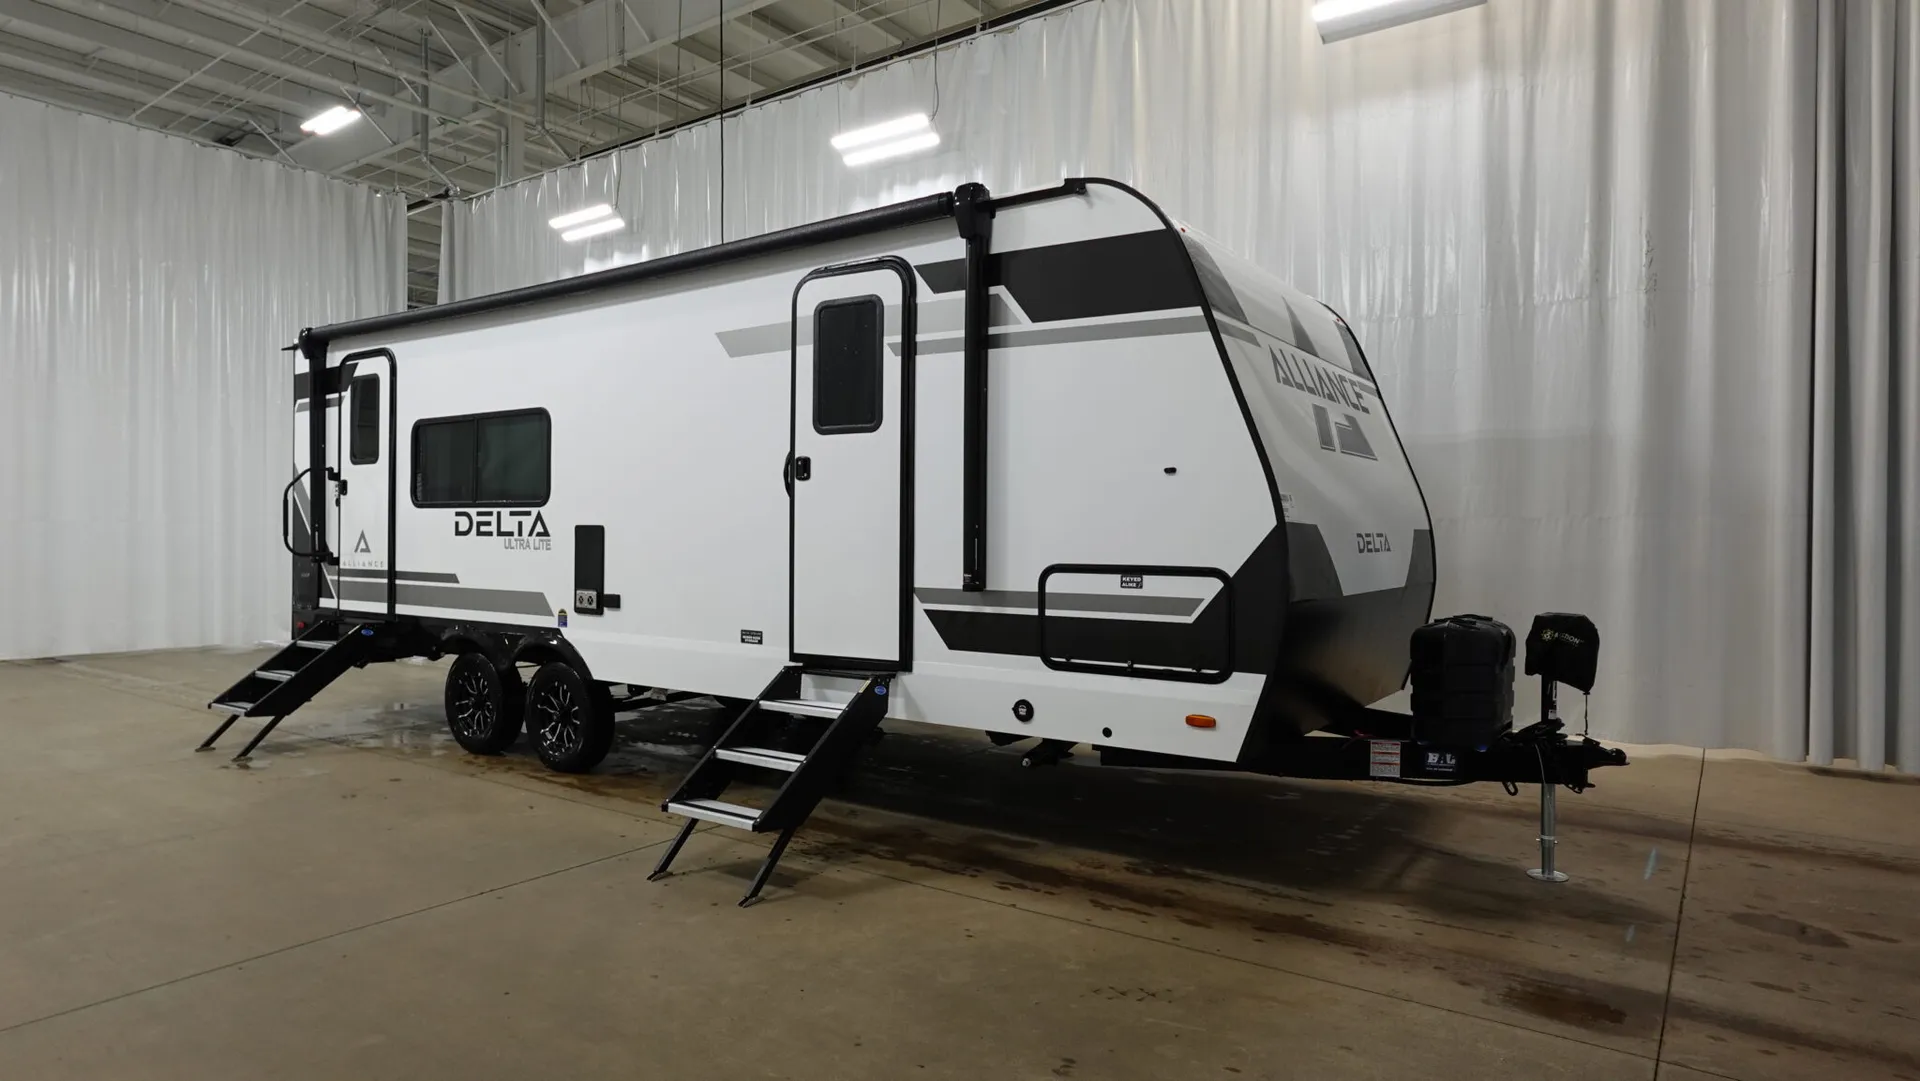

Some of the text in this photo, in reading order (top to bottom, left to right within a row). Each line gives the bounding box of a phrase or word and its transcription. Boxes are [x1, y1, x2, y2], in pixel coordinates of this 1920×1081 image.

[1268, 344, 1370, 414] ALLIANCE
[455, 510, 551, 537] DELTA
[504, 538, 552, 551] ULTRA LITE
[1356, 532, 1391, 553] DELTA
[342, 560, 384, 568] ALLIANCE
[1427, 752, 1456, 765] BL
